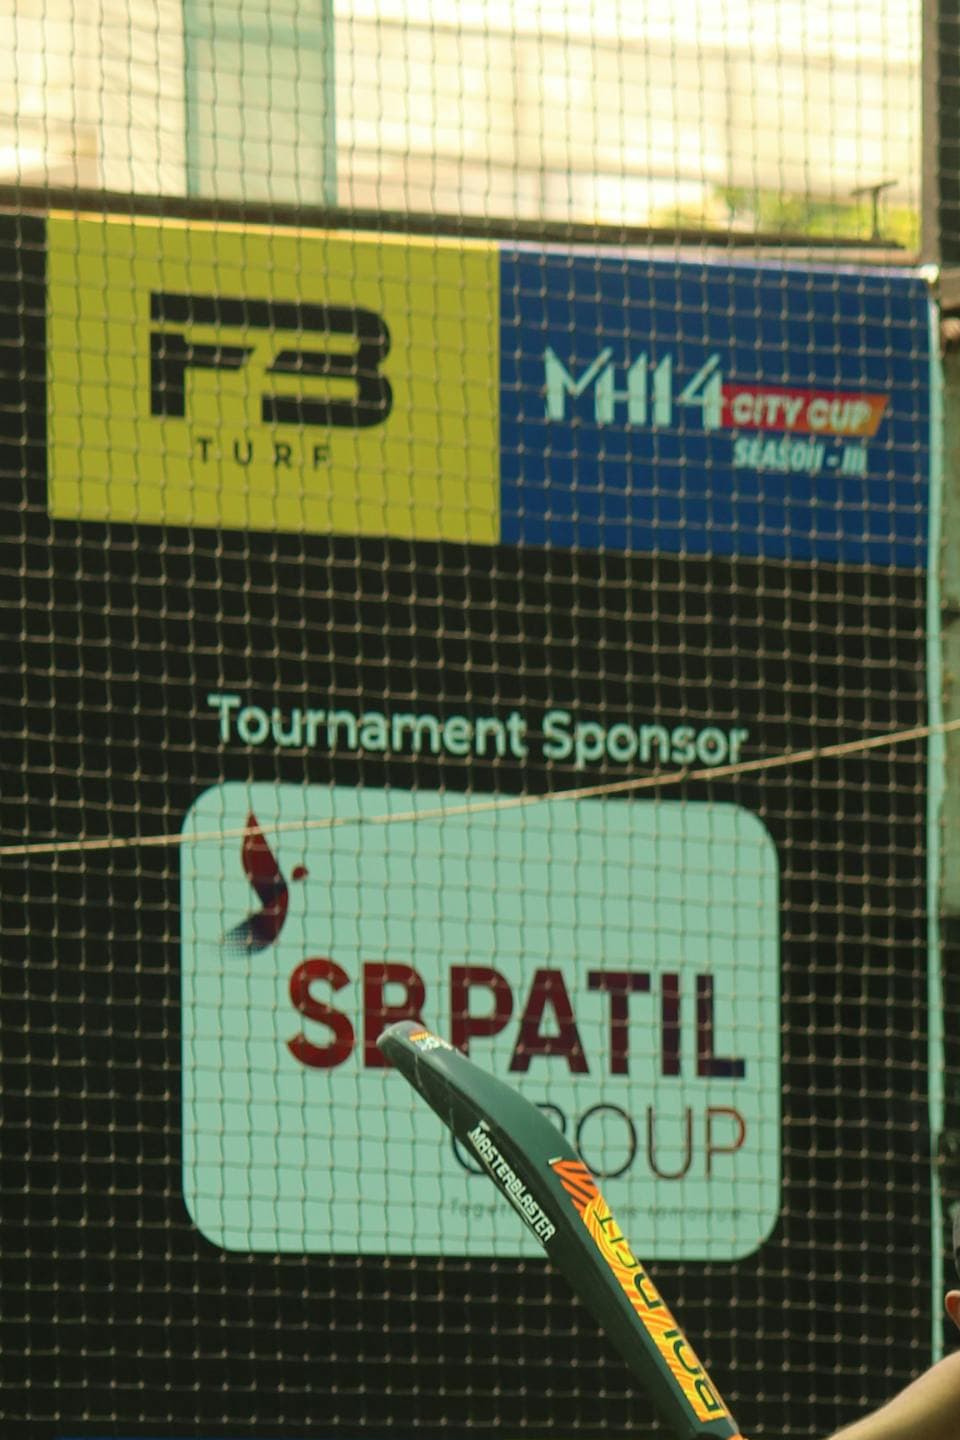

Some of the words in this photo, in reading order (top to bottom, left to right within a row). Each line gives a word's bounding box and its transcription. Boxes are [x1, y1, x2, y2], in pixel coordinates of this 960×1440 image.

[732, 394, 803, 425] CITY
[806, 397, 871, 431] CUP
[197, 436, 331, 469] TURF
[733, 437, 825, 471] SEASON
[207, 694, 529, 756] Tournament
[541, 711, 750, 769] Sponsor
[287, 958, 426, 1070] SB
[449, 964, 745, 1079] PATIL
